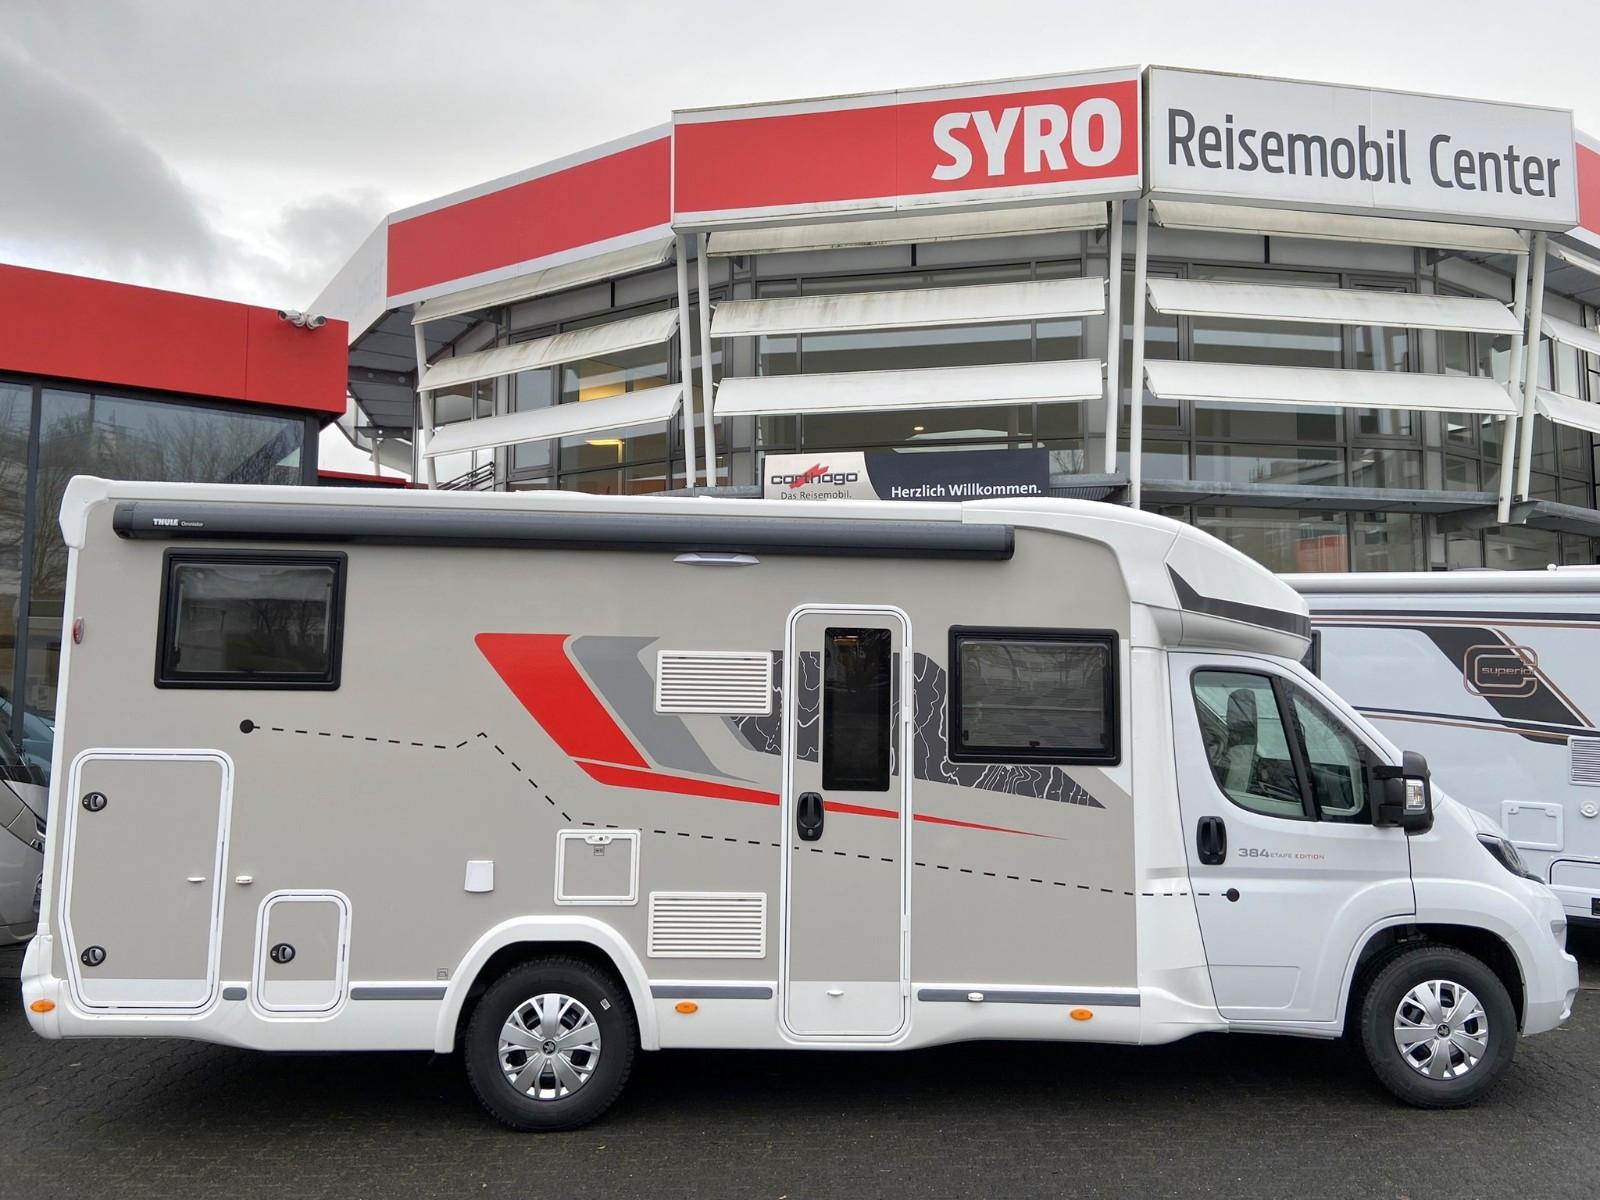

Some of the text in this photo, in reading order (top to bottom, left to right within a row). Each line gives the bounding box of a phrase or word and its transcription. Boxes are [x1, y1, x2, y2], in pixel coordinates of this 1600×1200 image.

[931, 98, 1122, 181] SYRO
[1168, 108, 1561, 198] Reisemobil Center
[771, 471, 858, 486] carthago
[781, 490, 852, 500] Das Reisemobil.
[891, 483, 1042, 498] Herzlich Willkommen.
[153, 518, 179, 526] THULE
[1238, 848, 1270, 858] 384
